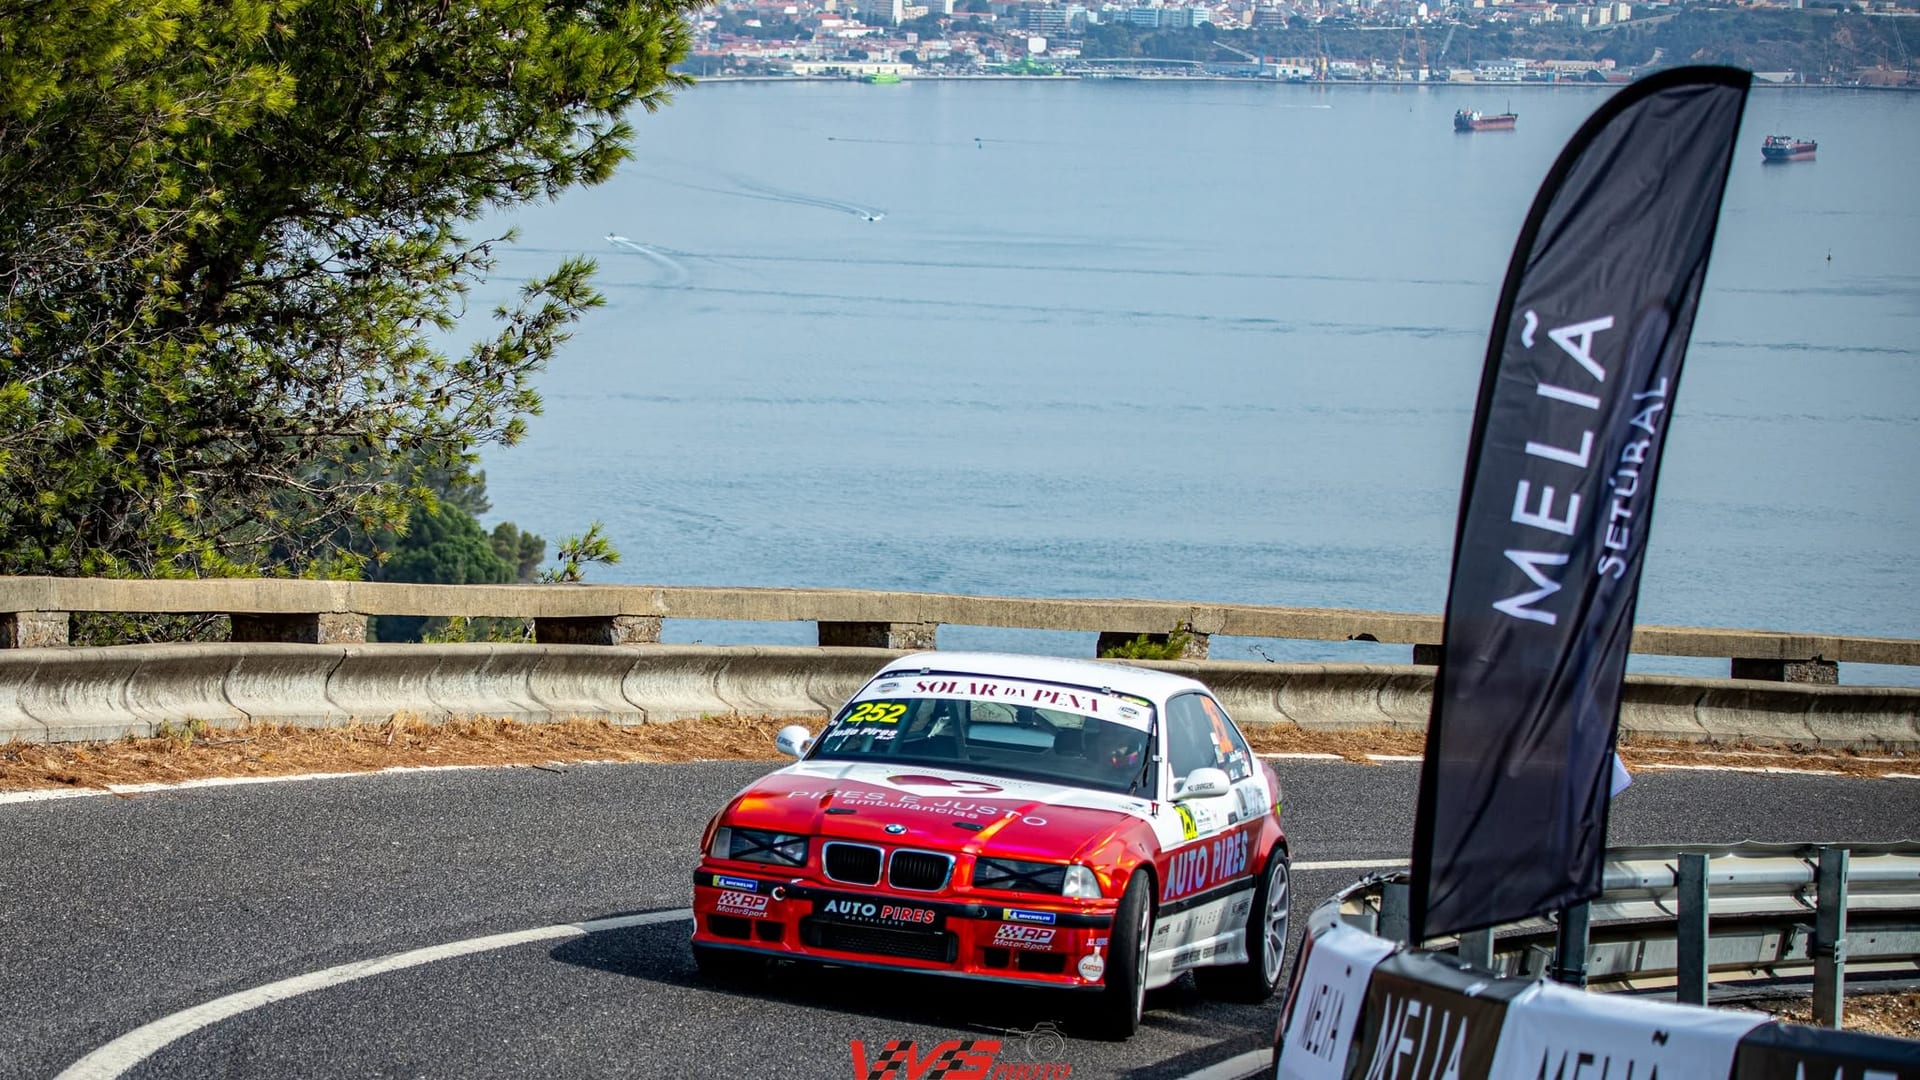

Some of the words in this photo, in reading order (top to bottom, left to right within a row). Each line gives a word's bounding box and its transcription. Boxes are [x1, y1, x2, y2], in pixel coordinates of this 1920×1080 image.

[912, 680, 998, 696] SOLAR
[1004, 687, 1026, 698] DA
[1033, 689, 1099, 712] PENA
[847, 703, 907, 723] 252
[787, 789, 888, 801] PIRES
[899, 794, 922, 804] E
[933, 800, 1048, 826] JUSTO
[1163, 845, 1208, 900] AUTO
[1211, 830, 1248, 884] PIRES
[824, 899, 877, 916] AUTO
[880, 905, 936, 924] PIRES
